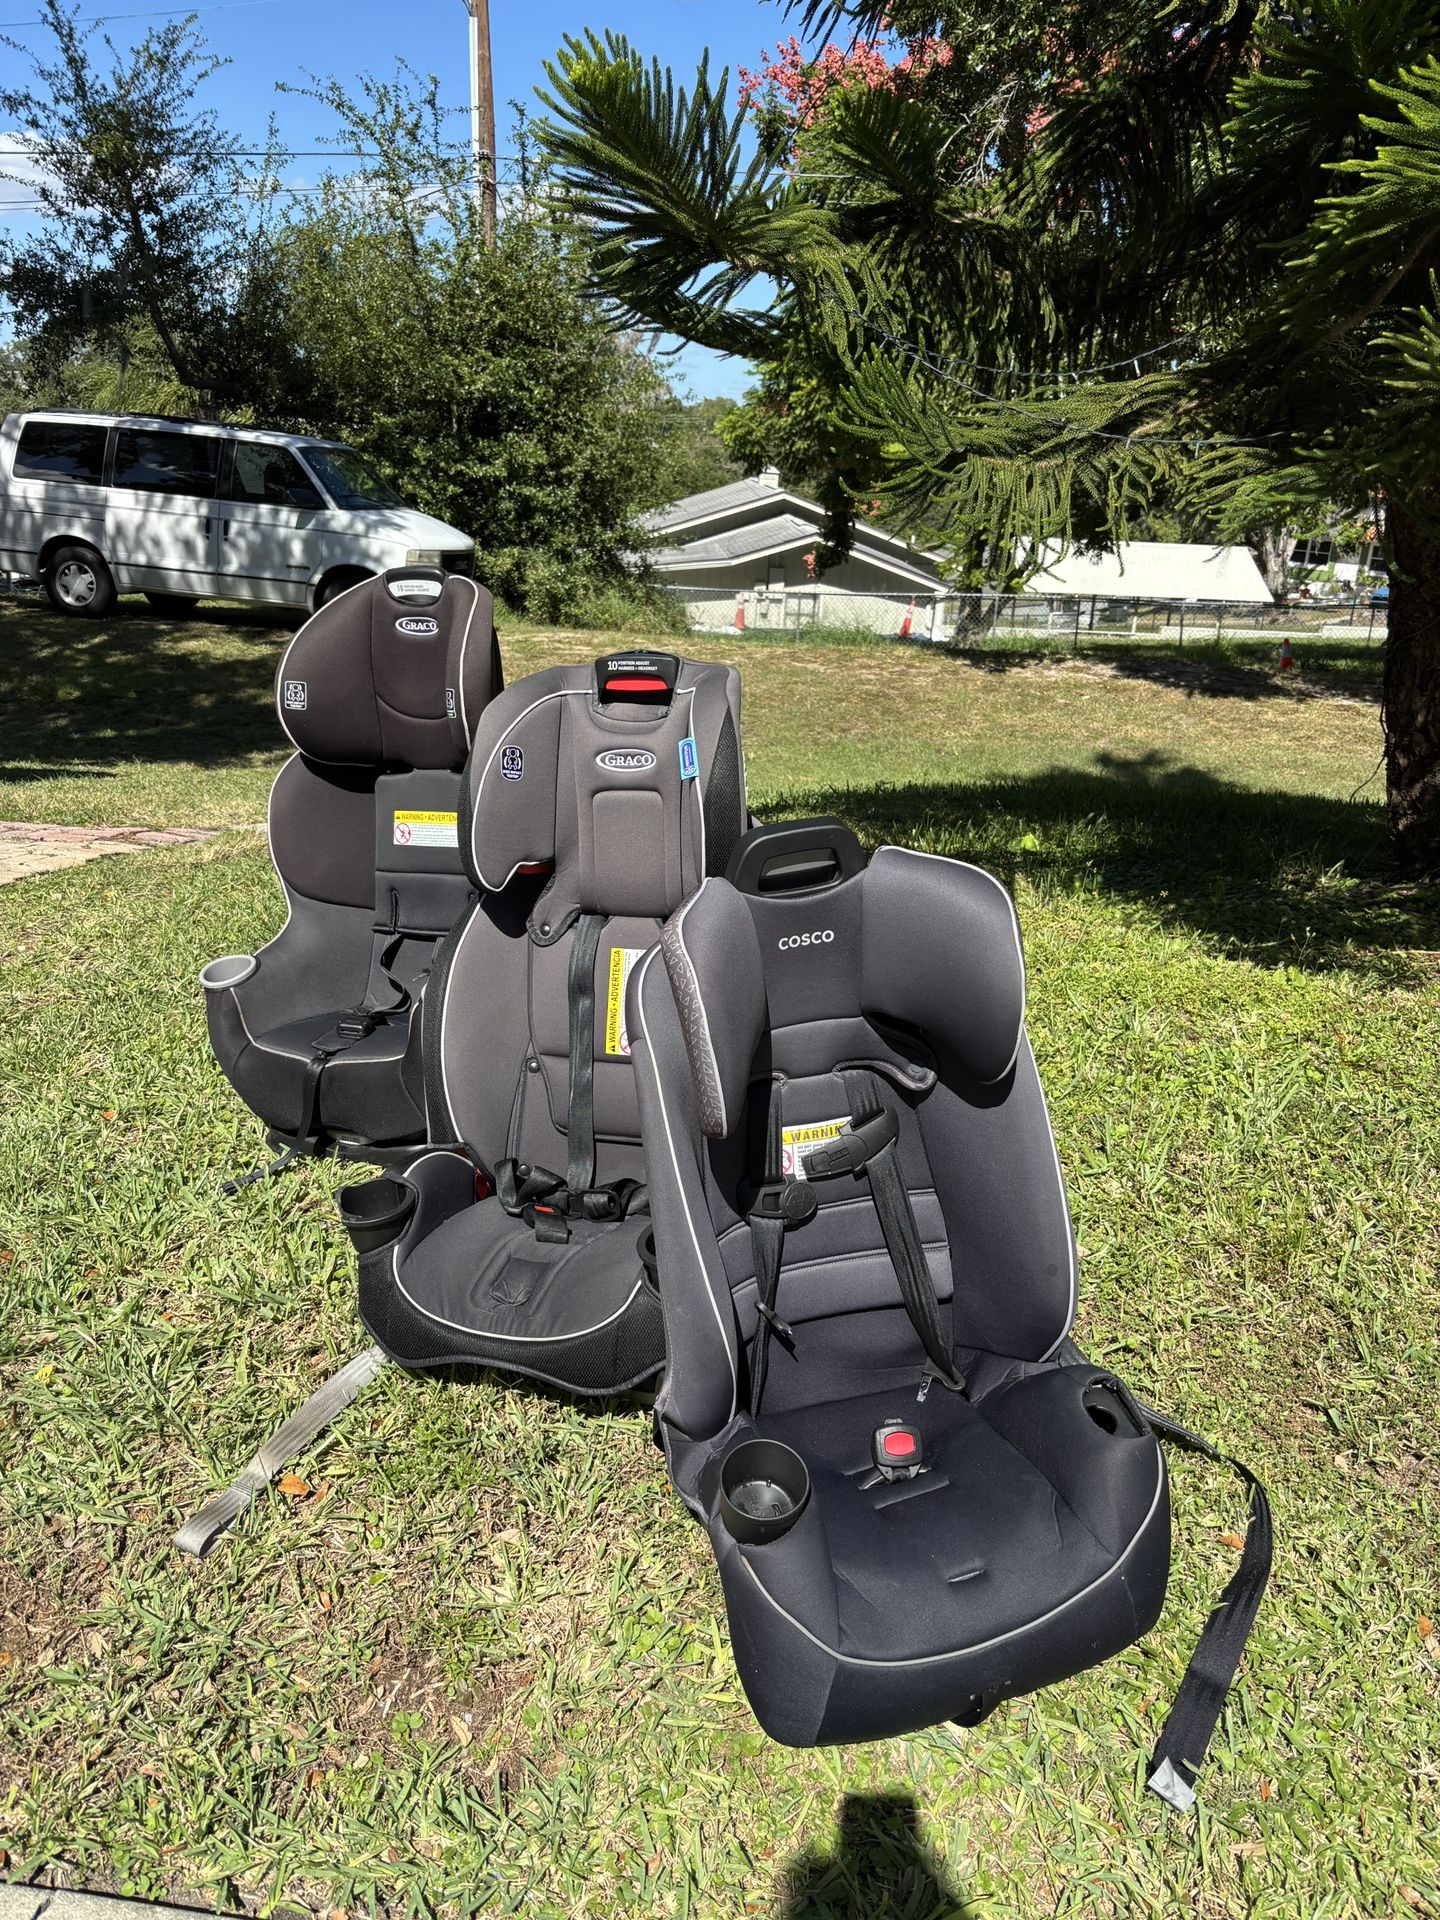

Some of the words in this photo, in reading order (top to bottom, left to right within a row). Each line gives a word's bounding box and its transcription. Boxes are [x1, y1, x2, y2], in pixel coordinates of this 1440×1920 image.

[402, 620, 437, 630] GRACO
[607, 661, 618, 670] 10
[605, 754, 652, 766] GRACO
[427, 814, 457, 822] ADVERTEN
[778, 929, 835, 951] COSCO
[612, 950, 620, 1002] ADVERTENCIA
[609, 1008, 617, 1042] WARNING
[791, 1125, 841, 1141] WARNIN
